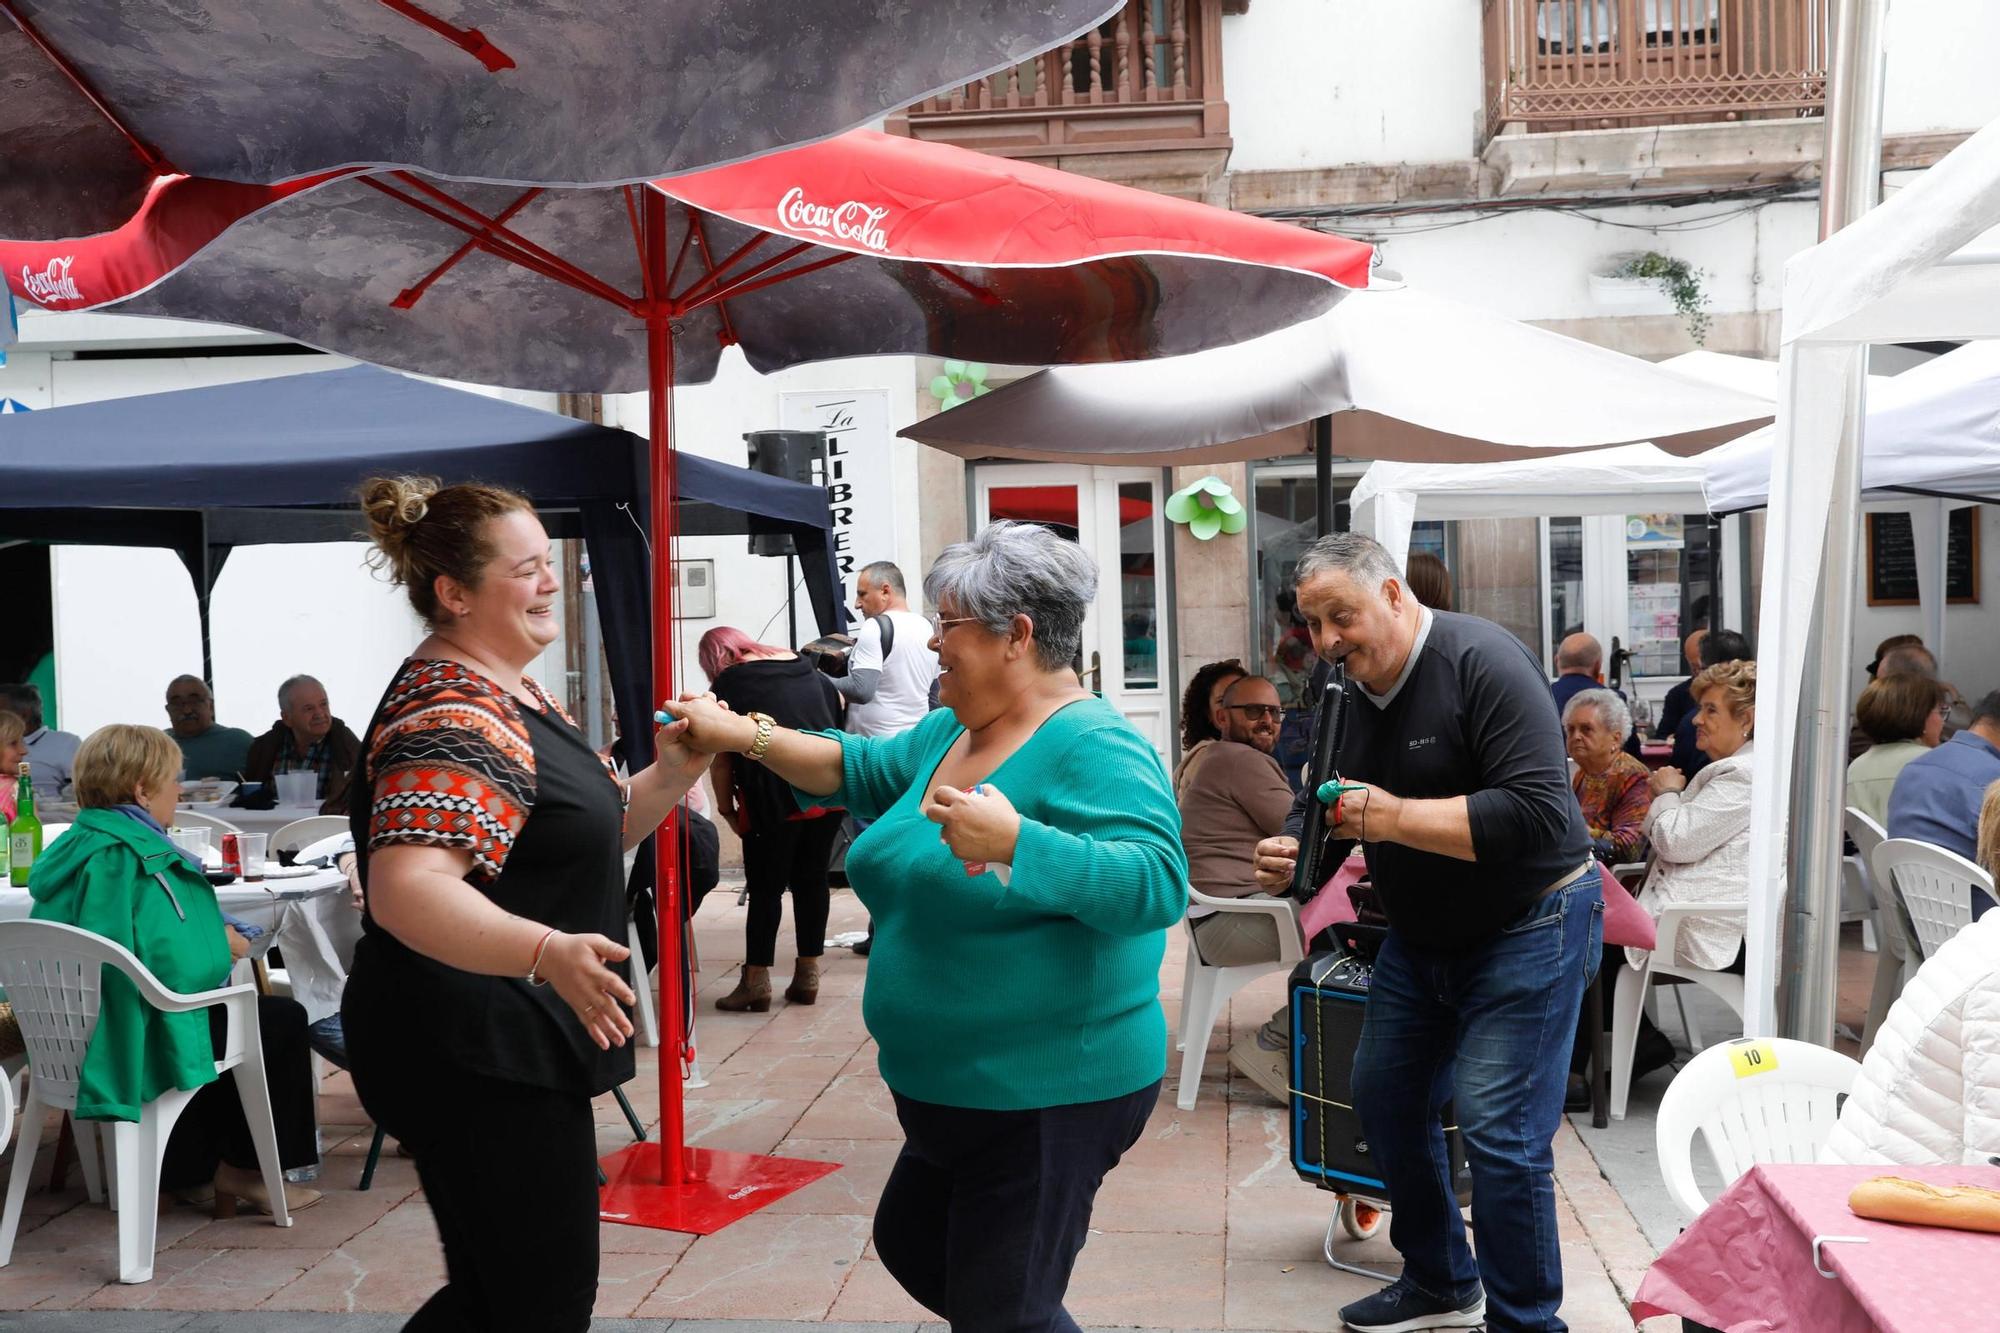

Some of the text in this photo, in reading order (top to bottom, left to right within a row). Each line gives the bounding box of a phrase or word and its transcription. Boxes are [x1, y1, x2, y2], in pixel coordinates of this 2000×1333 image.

[777, 186, 890, 253] Coca-Cola
[821, 407, 854, 428] La
[1744, 1049, 1761, 1066] 10
